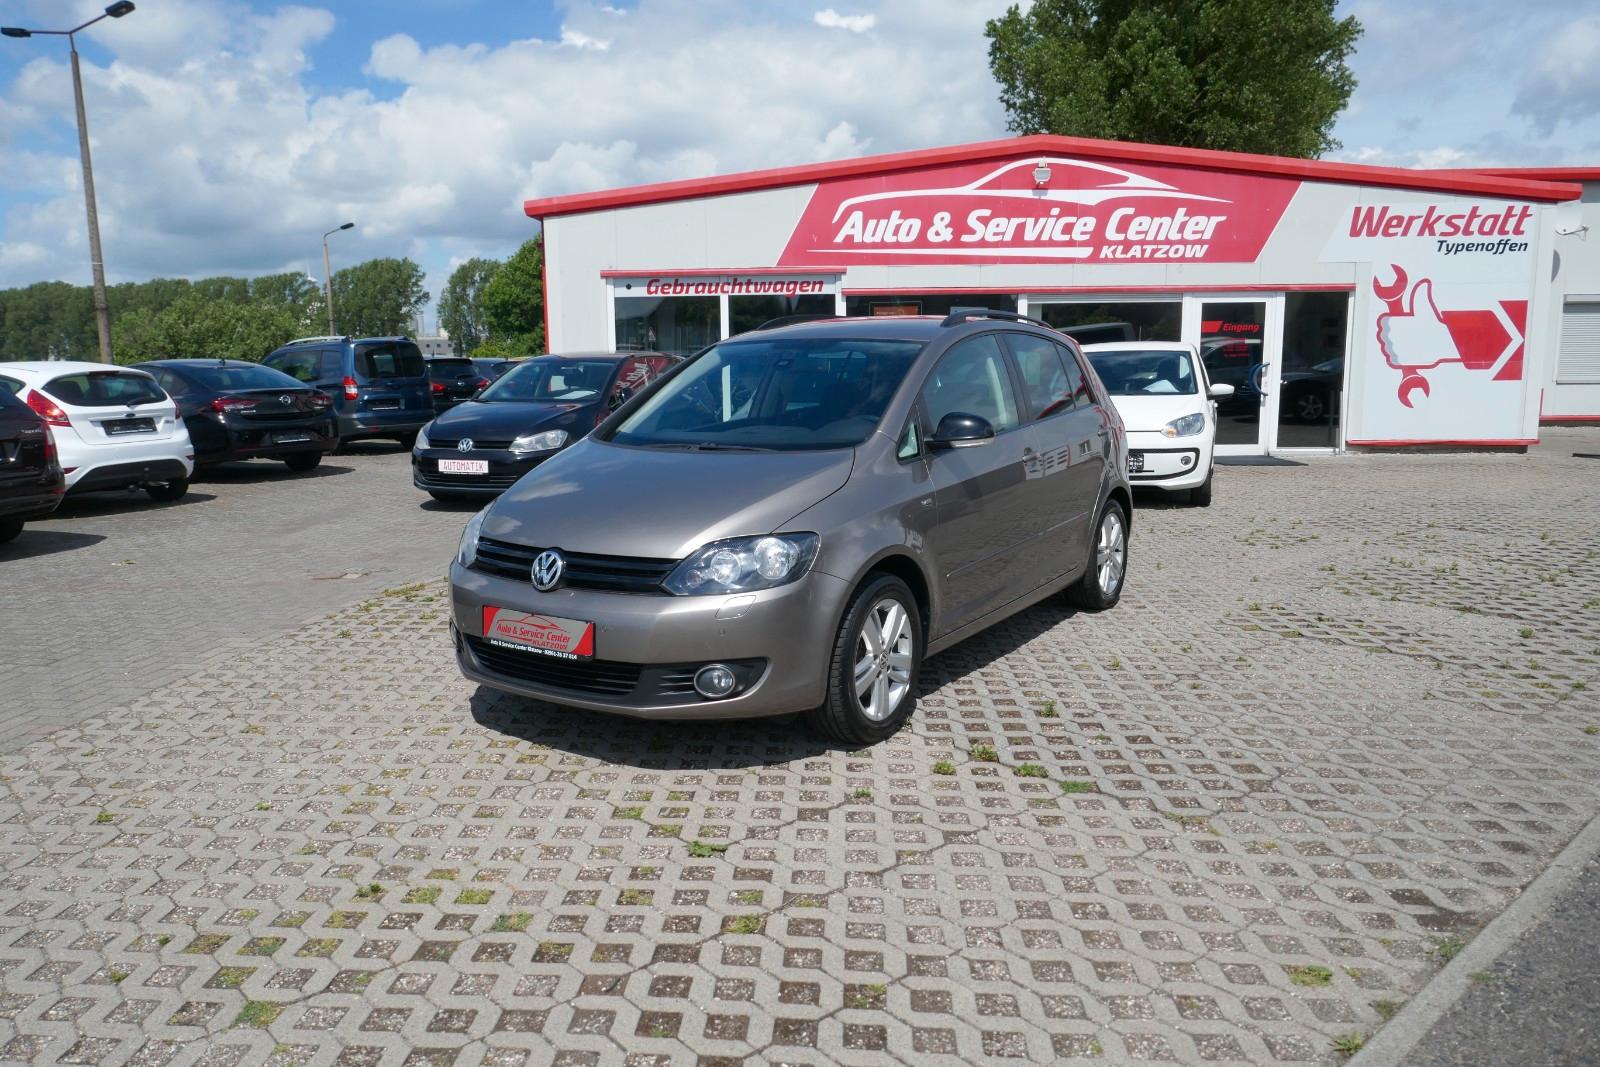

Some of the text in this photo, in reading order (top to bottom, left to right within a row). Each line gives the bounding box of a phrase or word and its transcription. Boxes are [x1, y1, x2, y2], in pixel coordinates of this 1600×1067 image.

[834, 207, 1226, 243] Auto & Service Center
[1350, 206, 1533, 237] Werkstatt
[1100, 244, 1209, 259] KLATZOW
[1437, 239, 1528, 255] Typenoffen
[646, 278, 824, 298] Gebrauchtwagen
[1223, 323, 1260, 333] Eingang
[443, 461, 484, 471] AUTOMATIK
[496, 623, 511, 633] Auto
[520, 627, 545, 639] Service
[547, 631, 570, 643] Center
[532, 640, 568, 650] KLATZOW
